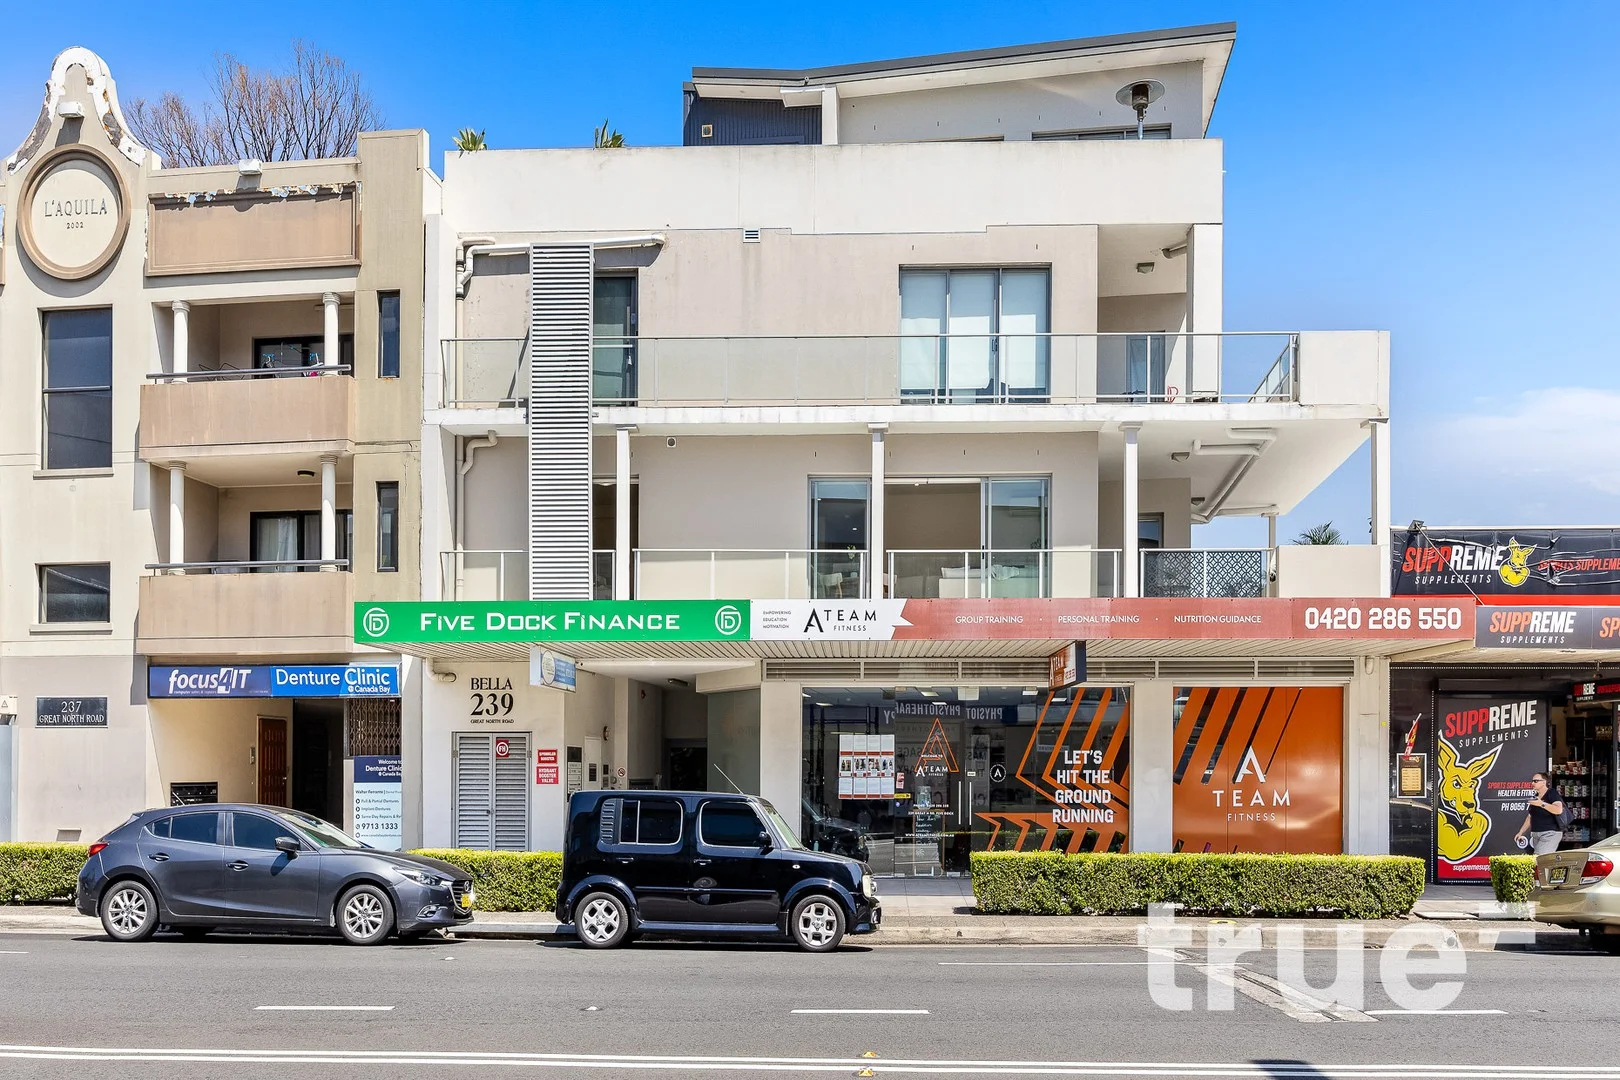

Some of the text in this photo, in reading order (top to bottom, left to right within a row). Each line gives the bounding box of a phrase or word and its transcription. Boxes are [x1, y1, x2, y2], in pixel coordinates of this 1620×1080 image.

[44, 198, 107, 217] L'AQUILA
[66, 221, 84, 229] 2002
[1402, 545, 1506, 572] SUPPREME
[1415, 574, 1492, 585] SUPPLEMENTS
[486, 612, 558, 631] DOCK
[824, 609, 877, 621] TEAM
[985, 615, 1023, 624] TRAINING
[1058, 615, 1140, 623] PERSONAL TRAINING
[1174, 615, 1261, 623] NUTRITION GUIDANCE
[1304, 607, 1462, 630] 0420 286 550
[1489, 611, 1577, 633] SUPPREME
[1500, 635, 1566, 644] SUPPLEMENTS
[276, 667, 390, 686] Denture Clinic
[355, 685, 378, 693] Canada
[379, 685, 391, 695] Bay
[470, 677, 513, 691] BELLA
[61, 700, 82, 713] 237
[470, 692, 514, 717] 239
[39, 713, 105, 724] GREAT NORTH ROAD
[1445, 700, 1538, 738] SUPPREME
[1458, 729, 1530, 748] SUPPLEMENTS
[1064, 749, 1103, 765] LET'S
[365, 764, 387, 772] Denture
[1235, 745, 1266, 783] A
[1056, 769, 1110, 784] HIT THE
[1488, 781, 1506, 789] SPORTS
[1055, 789, 1112, 804] GROUND
[1212, 789, 1291, 808] TEAM
[1497, 789, 1516, 797] HEALTH
[1501, 802, 1510, 811] PH
[1052, 808, 1114, 823] RUNNING
[1227, 812, 1277, 822] FITNESS
[361, 822, 399, 830] 9713 1333
